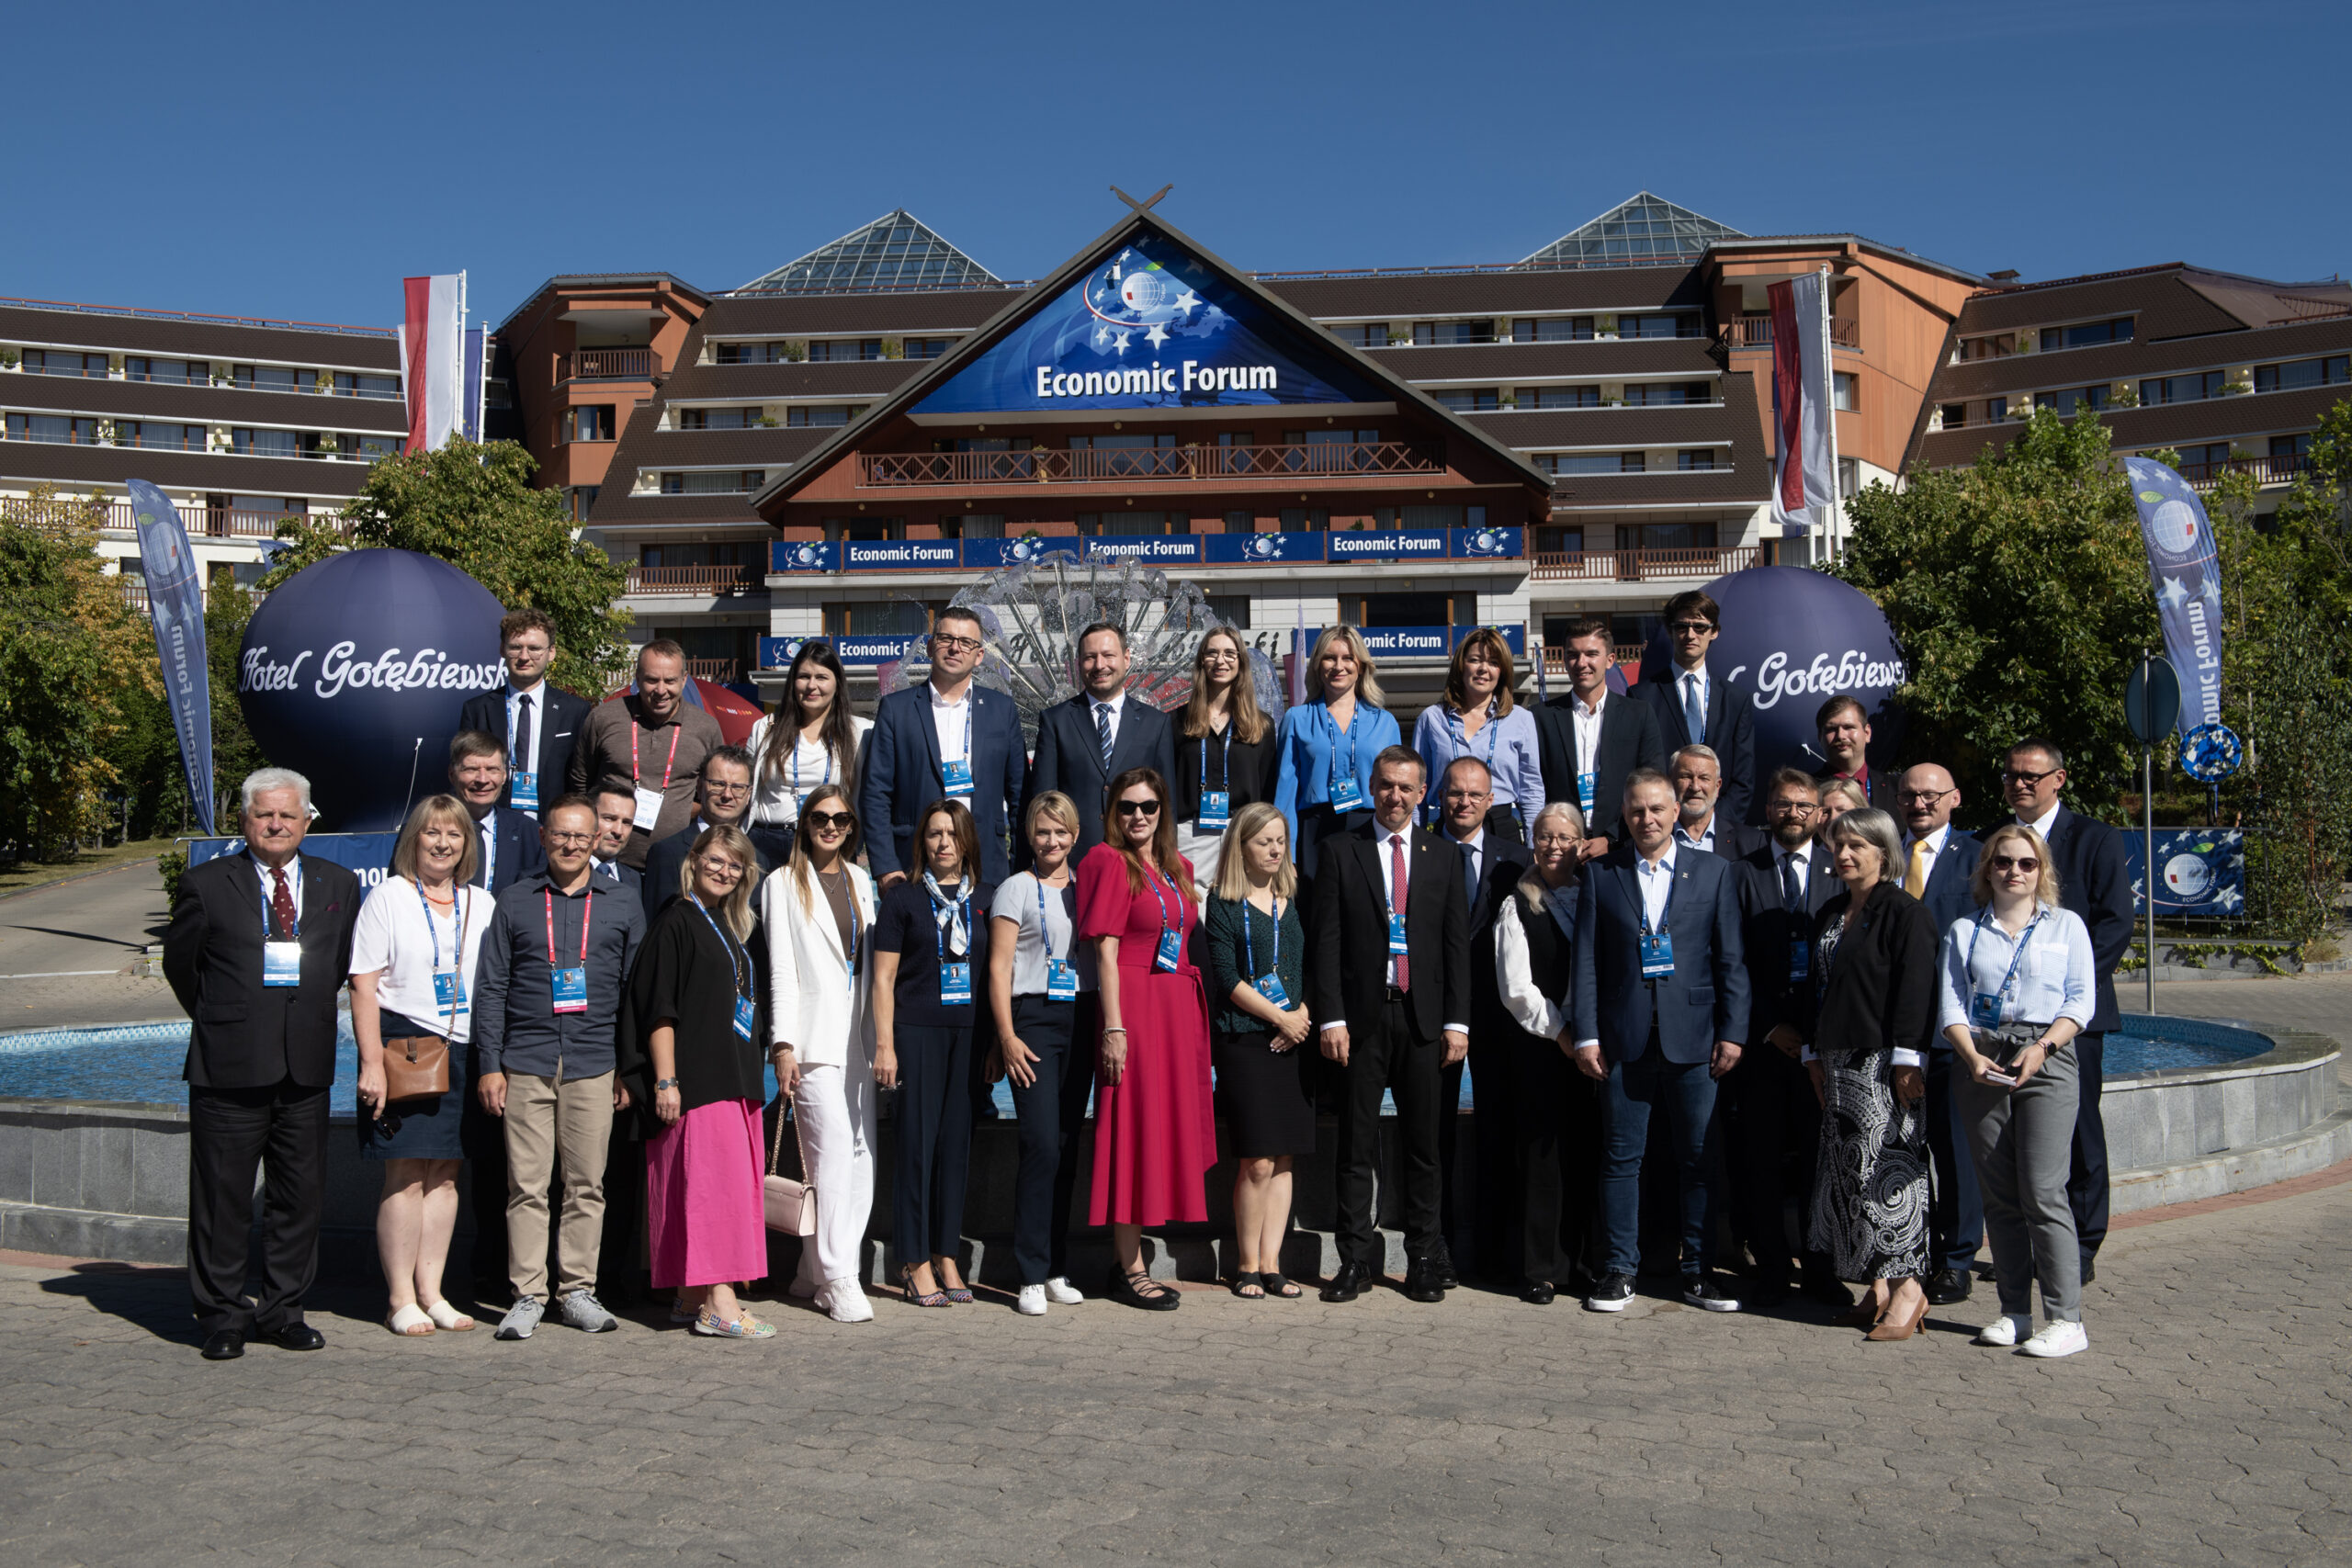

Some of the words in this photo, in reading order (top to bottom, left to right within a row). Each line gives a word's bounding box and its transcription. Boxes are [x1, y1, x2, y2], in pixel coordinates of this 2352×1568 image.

[1036, 360, 1177, 398] Economic
[1182, 360, 1278, 391] Forum
[1153, 540, 1194, 555] Forum
[1333, 536, 1396, 551] Economic
[1398, 536, 1442, 550] Forum
[850, 546, 910, 562] Economic
[913, 546, 954, 560] Forum
[1363, 632, 1396, 649] omic
[1398, 632, 1442, 648] Forum
[839, 641, 900, 657] Economic
[240, 646, 313, 693] Hotel
[315, 640, 509, 699] Gołębiewsk
